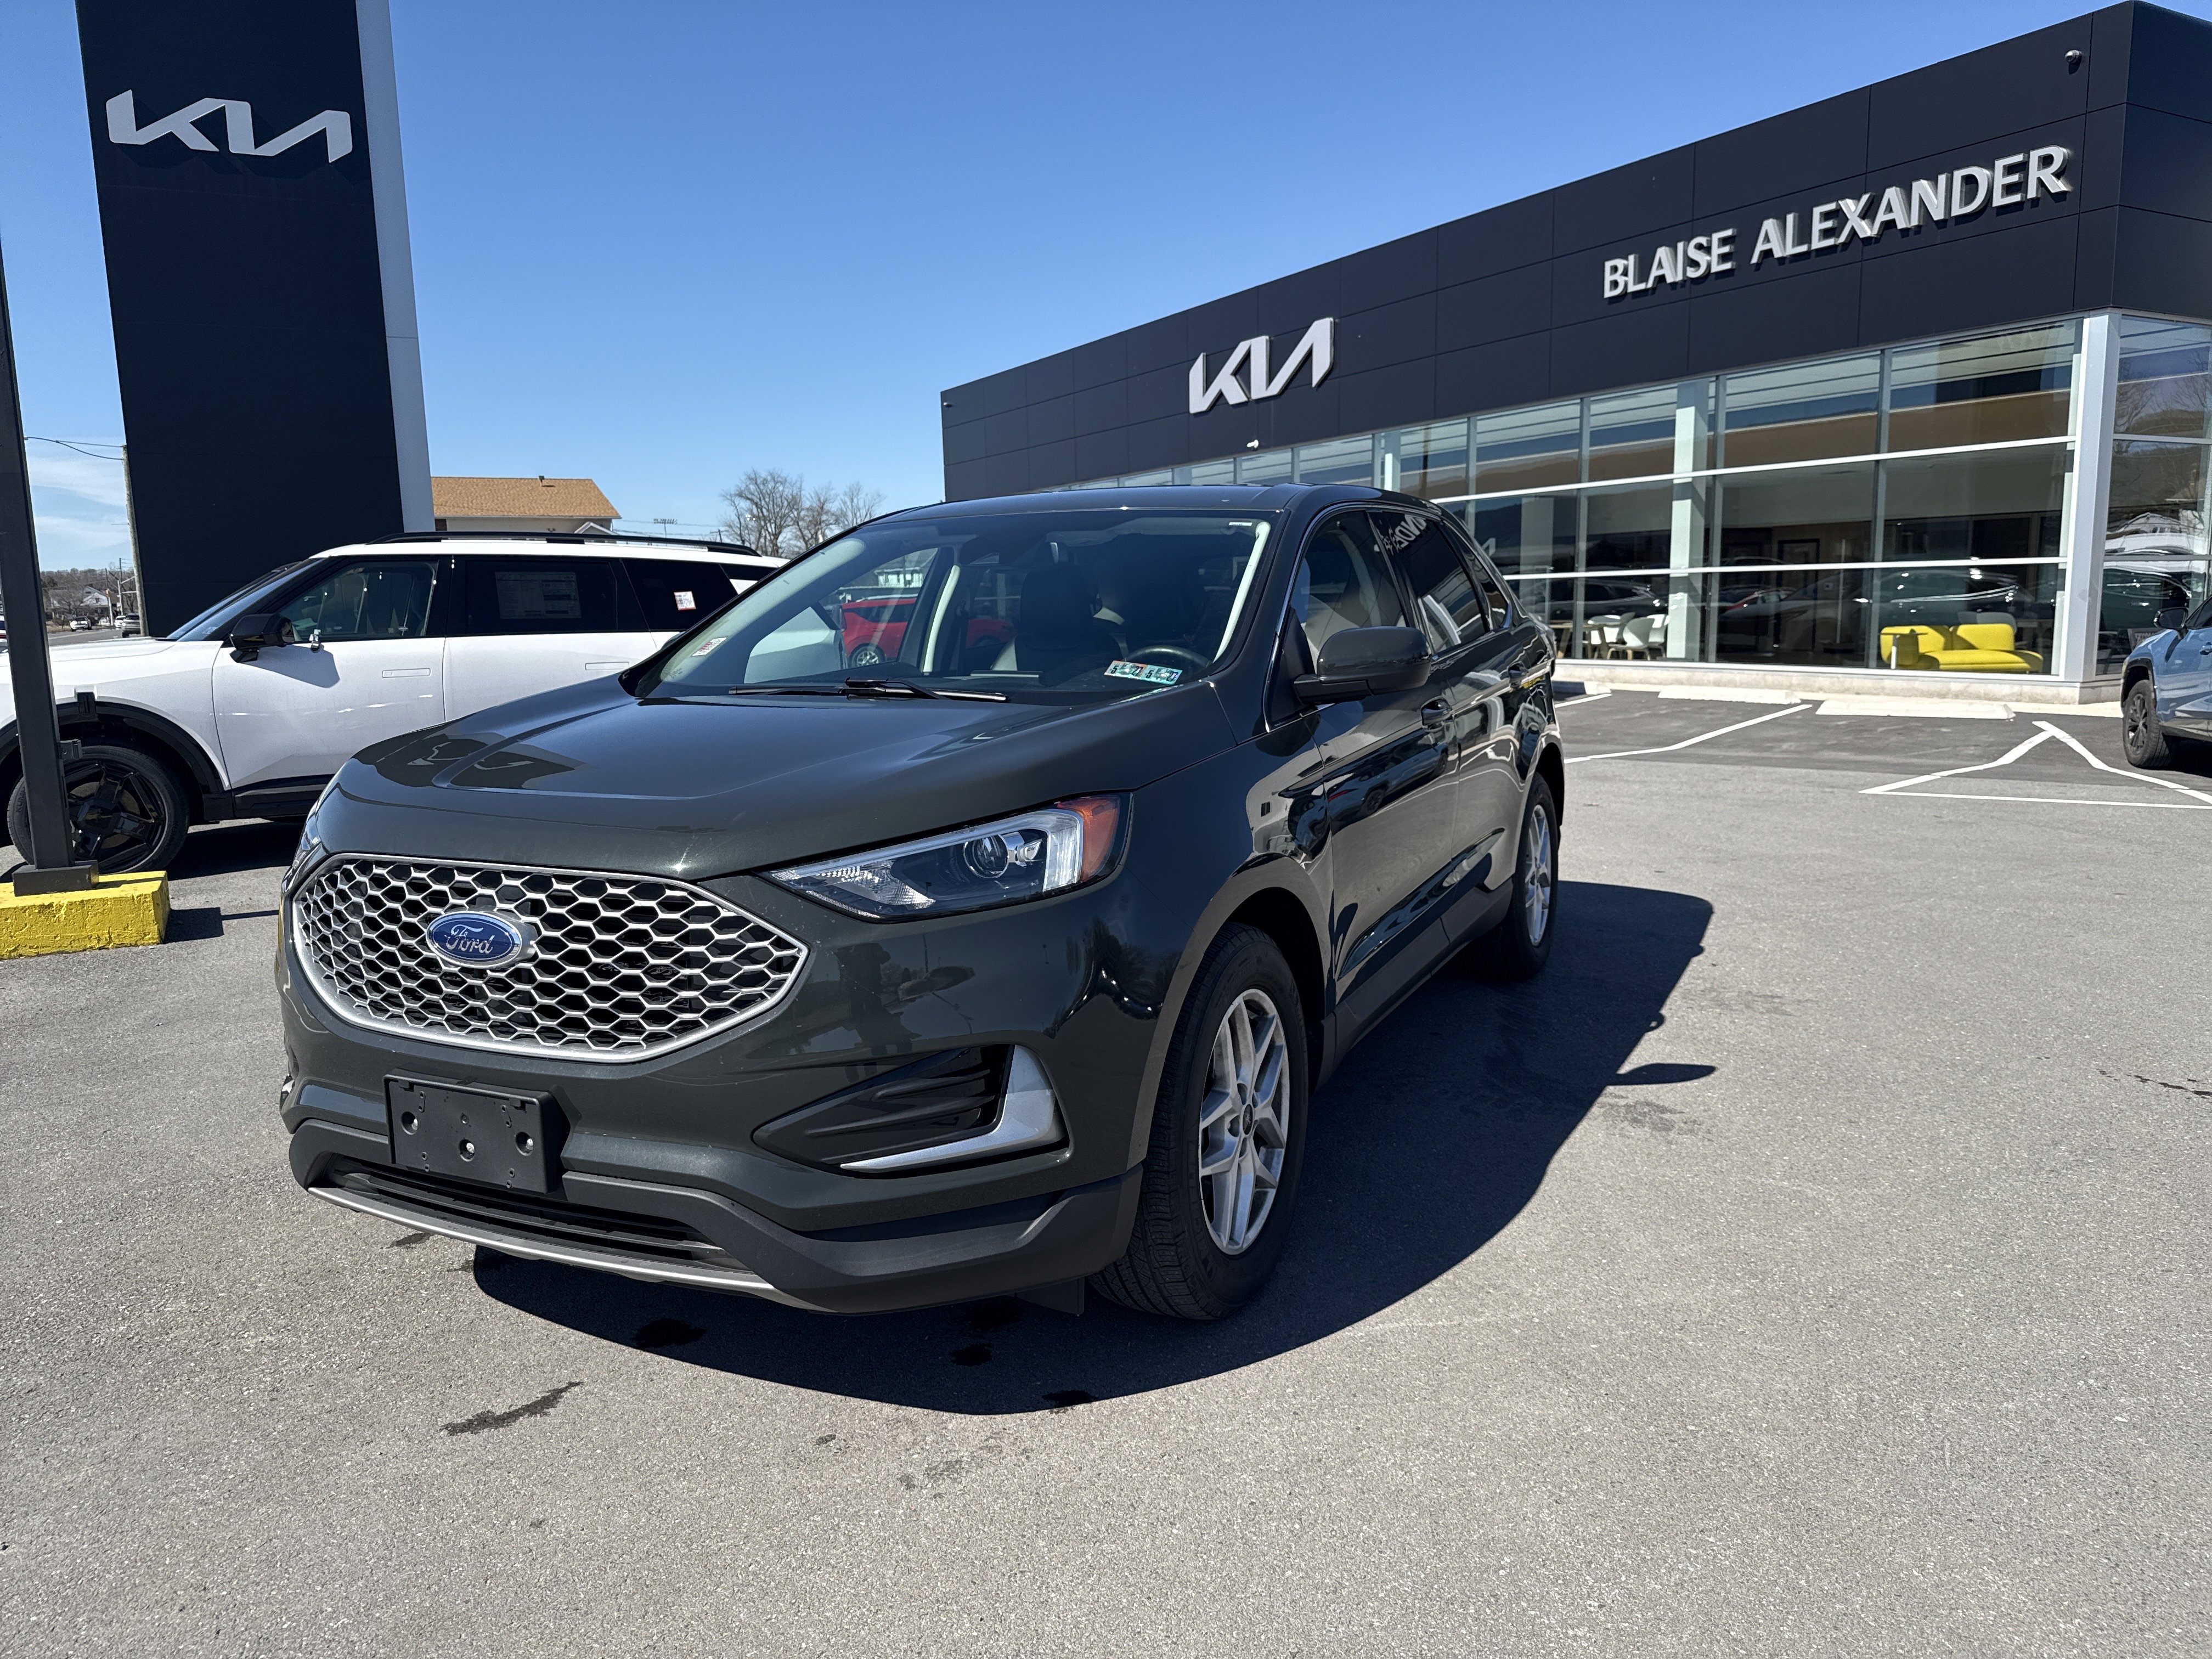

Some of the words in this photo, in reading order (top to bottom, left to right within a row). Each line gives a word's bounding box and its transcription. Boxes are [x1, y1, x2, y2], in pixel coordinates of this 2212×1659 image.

[106, 89, 352, 163] KIA
[1604, 228, 1736, 298] BLAISE
[1751, 145, 2072, 264] ALEXANDER
[1189, 317, 1334, 414] KIA
[1111, 665, 1120, 674] 5
[1146, 670, 1155, 679] 5
[444, 924, 495, 953] Ford
